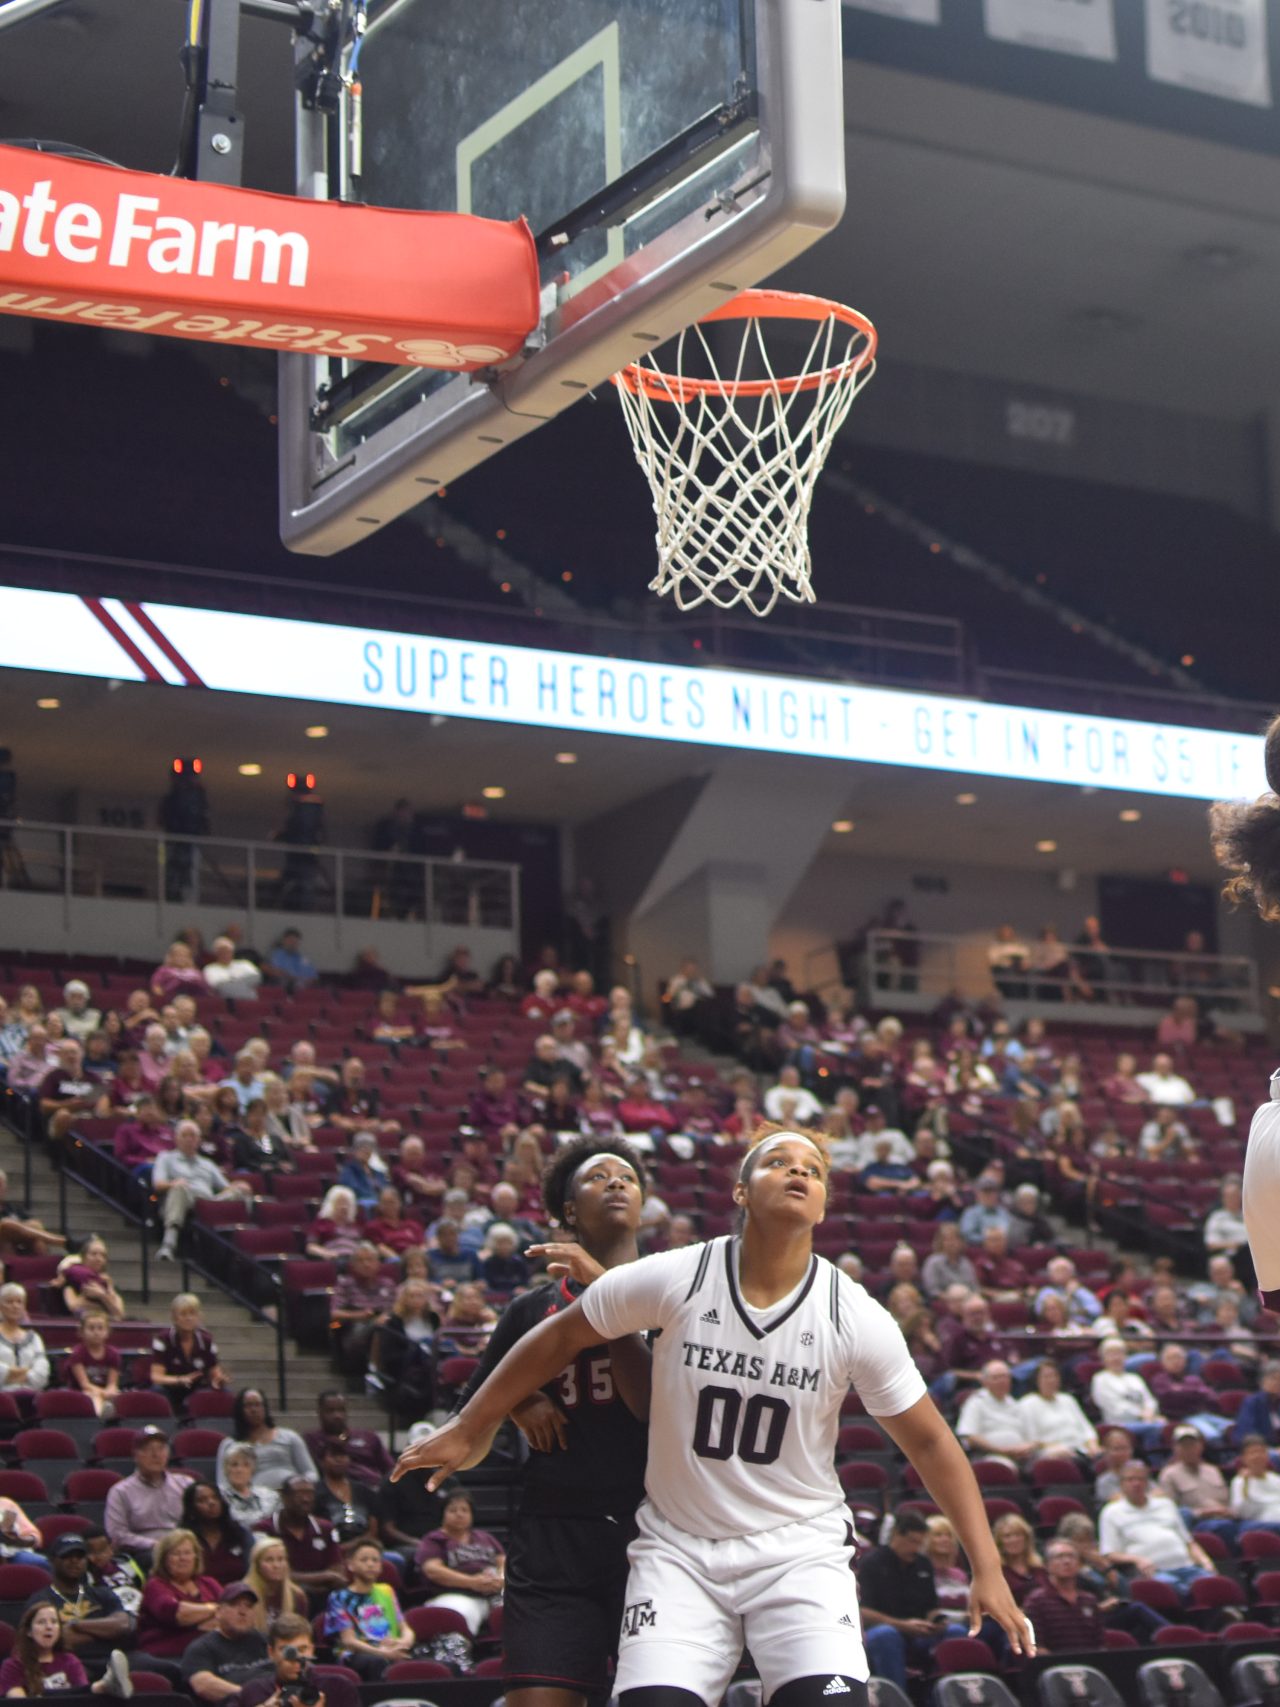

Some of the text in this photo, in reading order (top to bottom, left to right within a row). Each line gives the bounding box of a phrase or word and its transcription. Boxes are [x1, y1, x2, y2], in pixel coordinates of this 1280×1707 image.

[362, 640, 509, 708] SUPER
[537, 662, 706, 730] HEROES
[731, 684, 851, 746] NIGHT
[914, 706, 979, 760] GET
[1005, 718, 1041, 766] IN
[1063, 722, 1132, 777] FOR
[559, 1358, 615, 1406] 35
[683, 1341, 821, 1392] TEXAS A&M
[693, 1384, 790, 1465] 00
[822, 1685, 851, 1696] adidas
